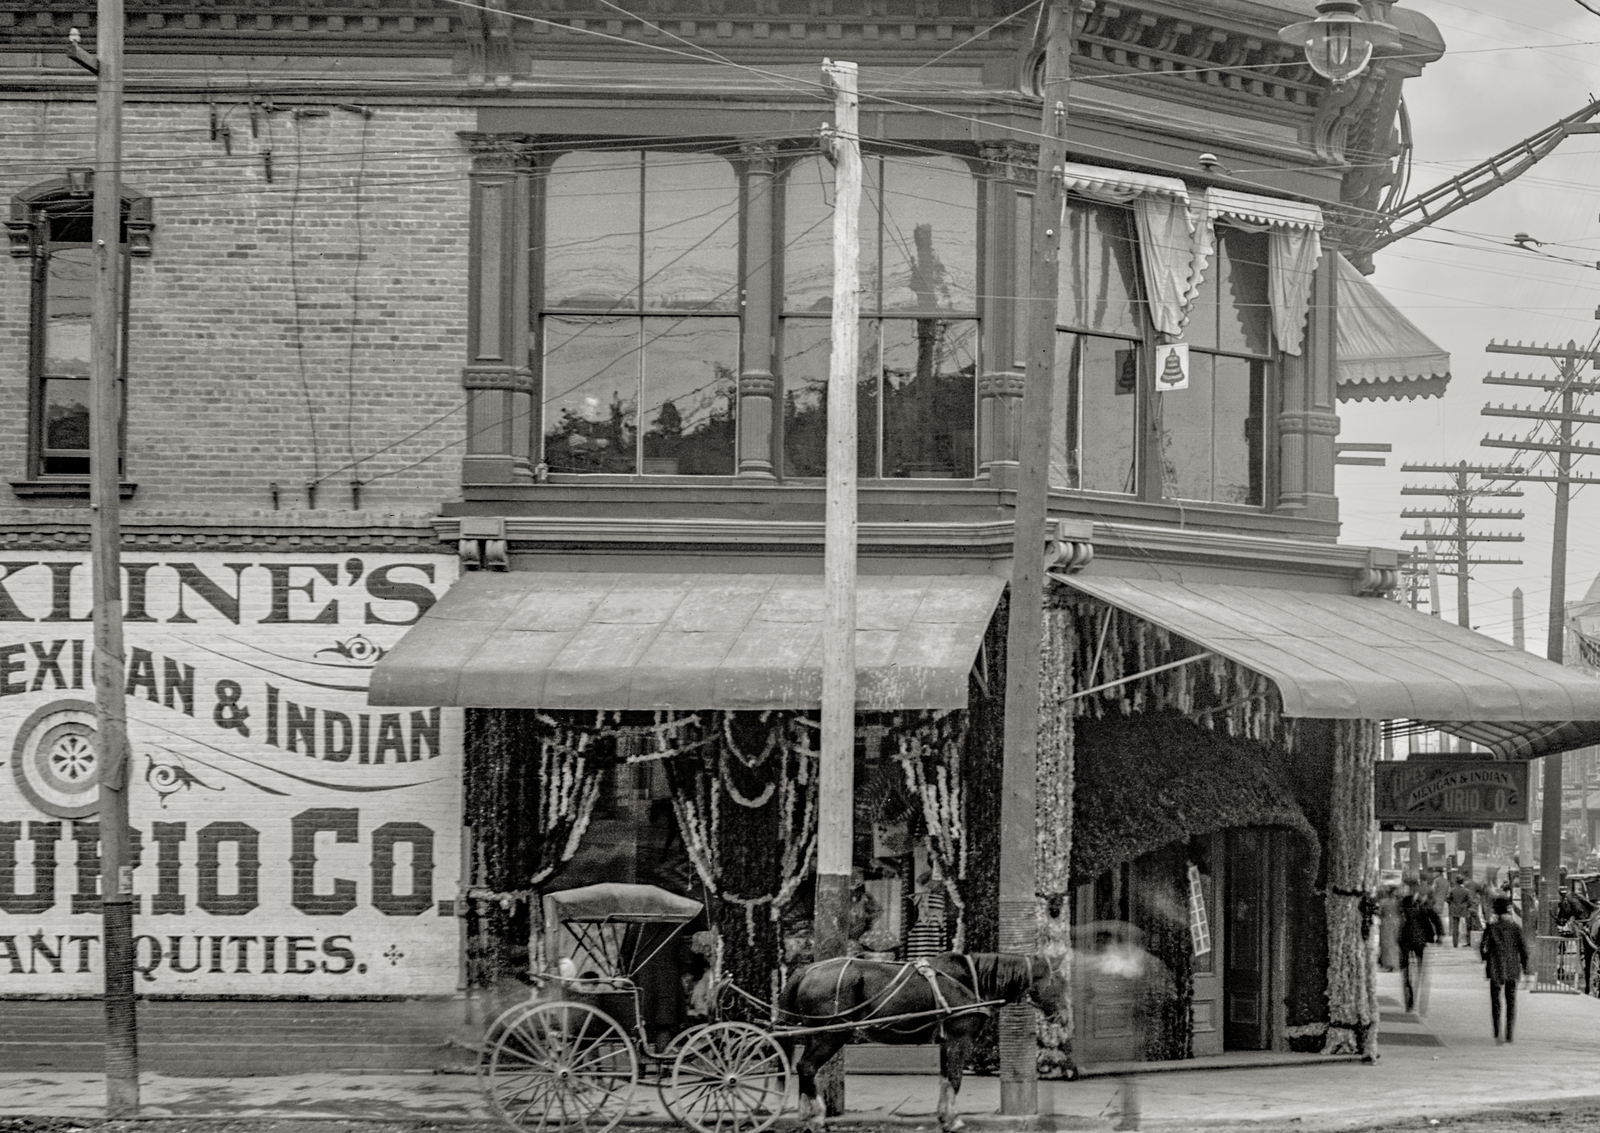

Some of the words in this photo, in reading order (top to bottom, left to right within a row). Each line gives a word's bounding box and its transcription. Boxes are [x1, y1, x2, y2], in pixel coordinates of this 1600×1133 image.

[0, 639, 196, 718] EXIAN
[213, 679, 251, 738] &
[265, 682, 441, 765] INDIAN
[1412, 774, 1457, 802] MEXICAN
[1460, 774, 1468, 784] &
[1470, 770, 1508, 784] INDIAN
[0, 934, 368, 982] ANTQUITIES.
